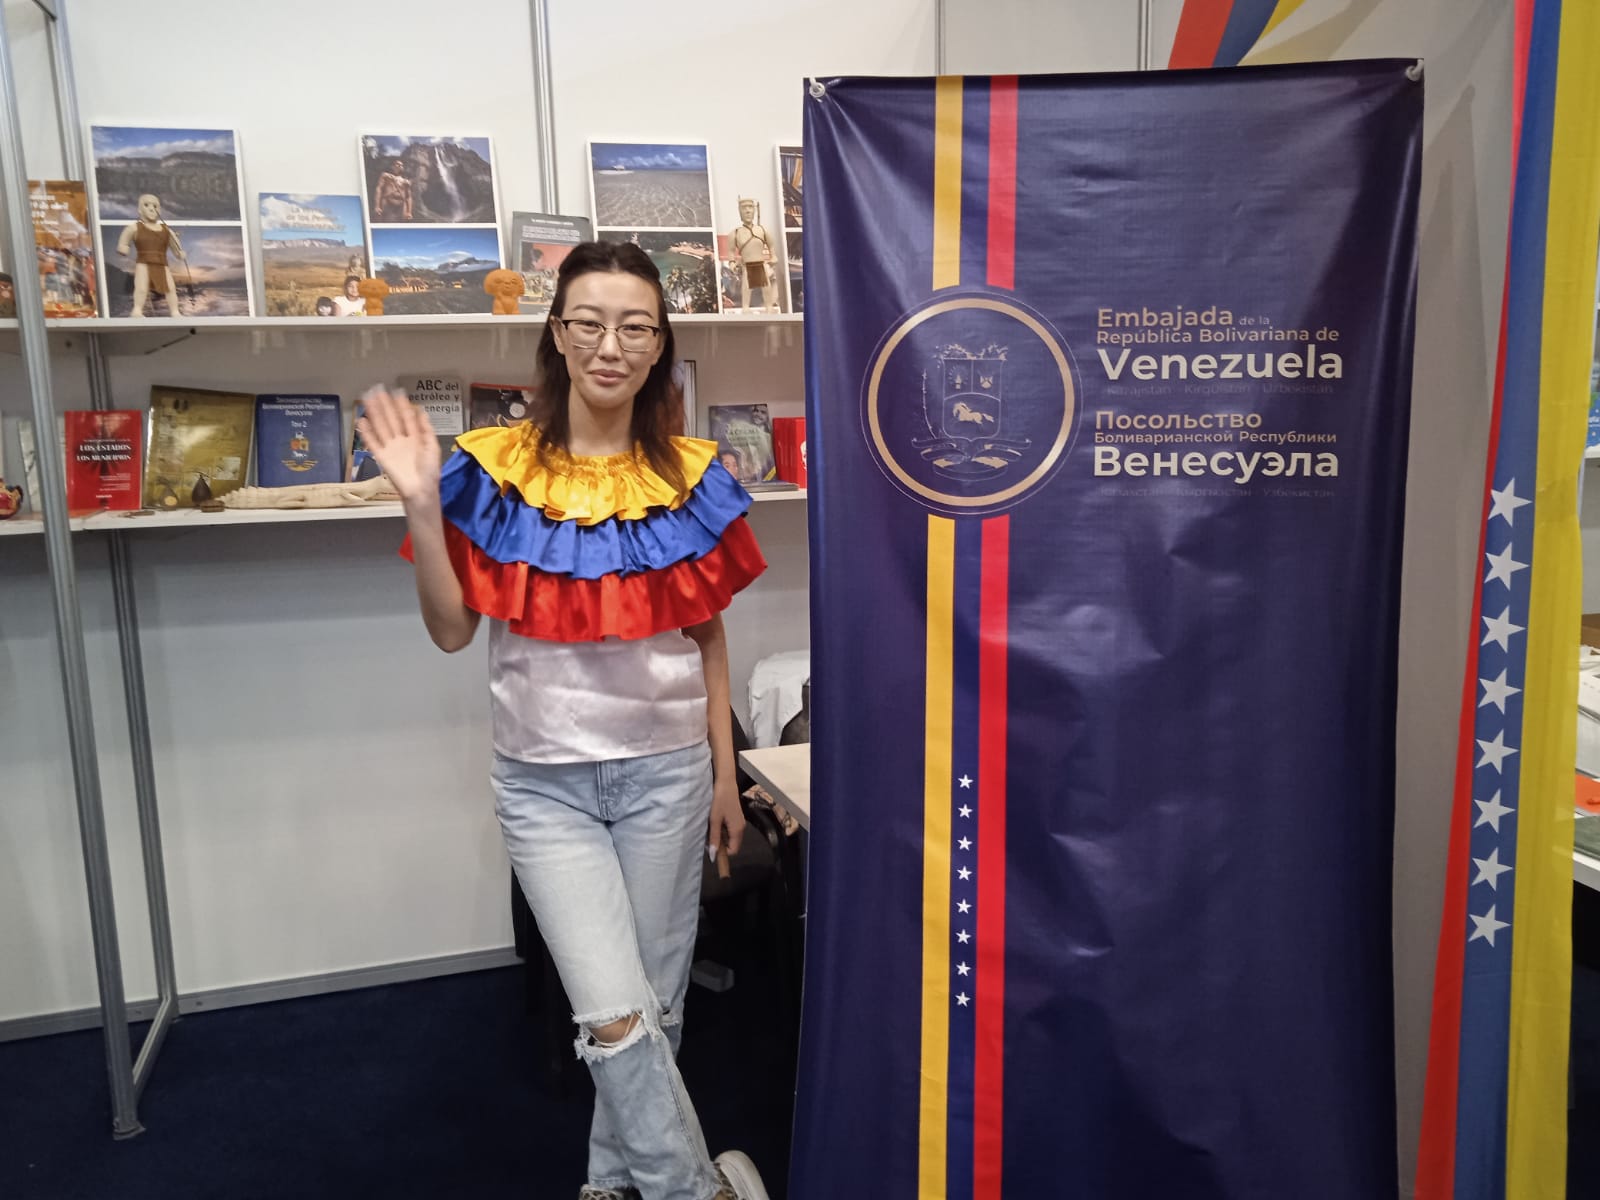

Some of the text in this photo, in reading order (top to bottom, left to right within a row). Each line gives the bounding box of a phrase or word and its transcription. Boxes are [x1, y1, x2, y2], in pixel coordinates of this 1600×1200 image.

[1097, 306, 1270, 330] Embajada de la
[1097, 327, 1339, 346] República Bolivariana de
[1097, 344, 1343, 380] Venezuela
[416, 380, 459, 391] ABC del
[454, 394, 460, 402] y
[1095, 411, 1262, 430] Посольство
[1094, 430, 1337, 445] Боливарианской Республики
[96, 444, 131, 452] ESTADOS
[76, 454, 90, 462] LOS
[1093, 446, 1339, 484] Венесуэла
